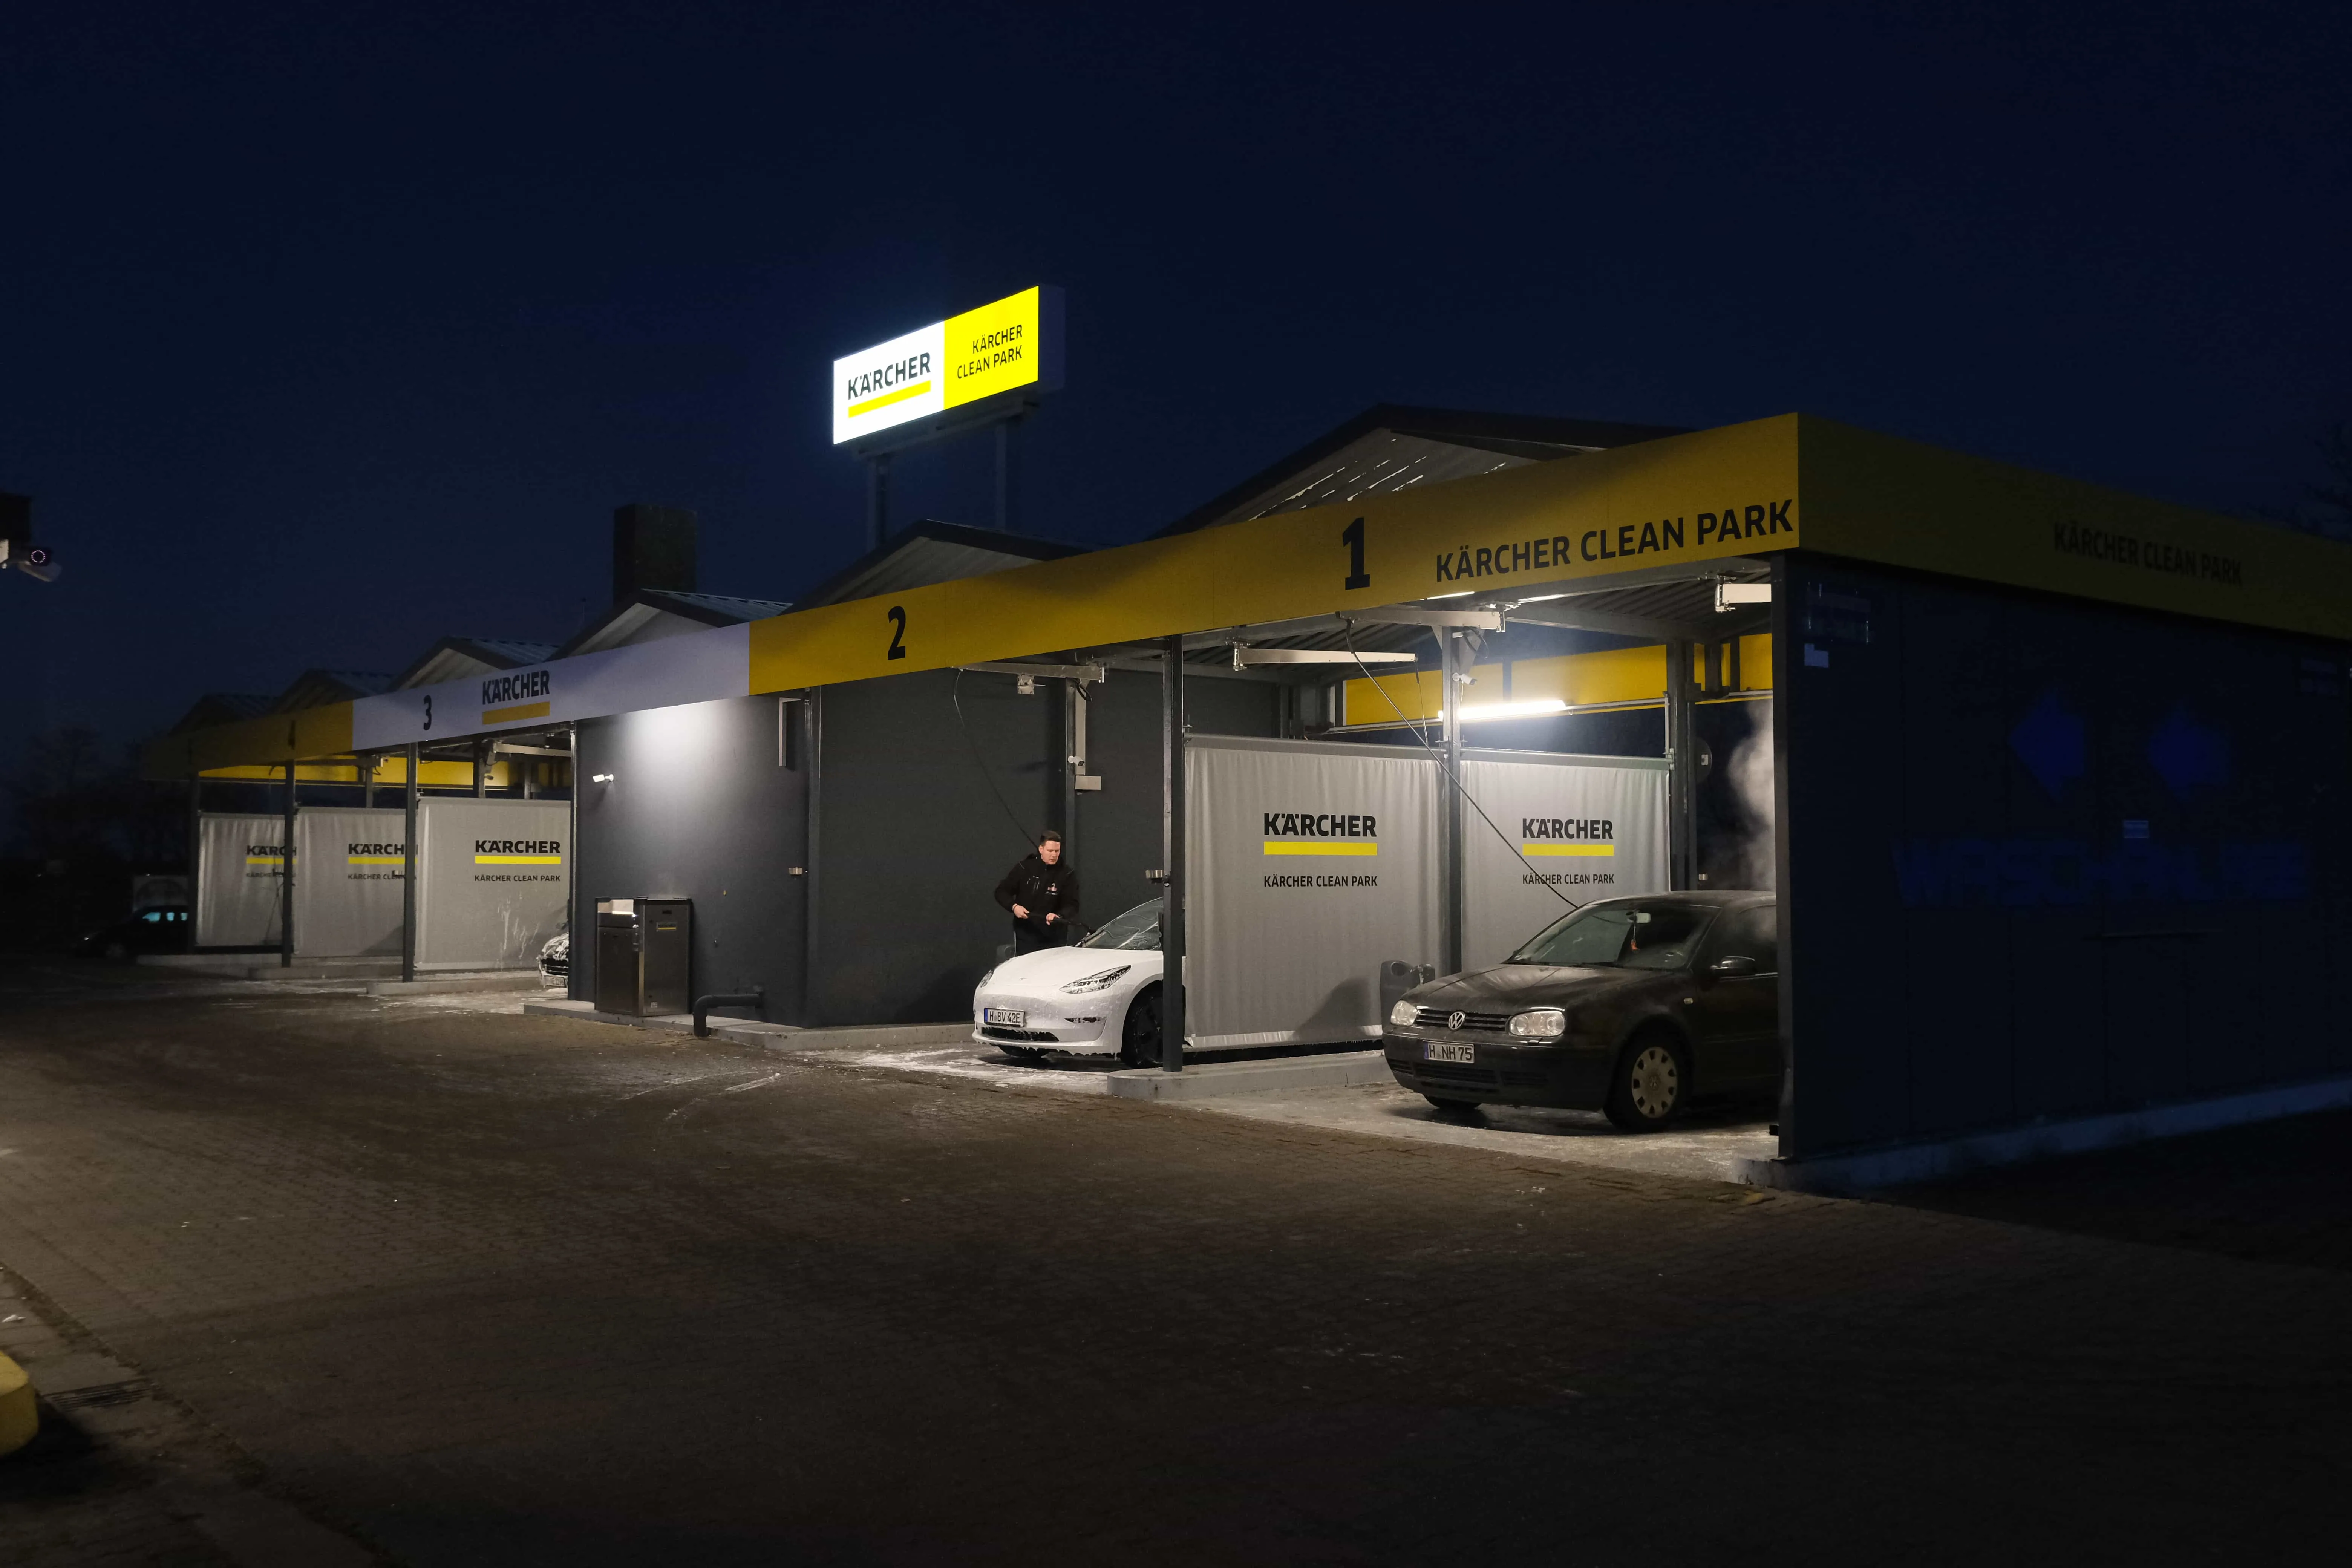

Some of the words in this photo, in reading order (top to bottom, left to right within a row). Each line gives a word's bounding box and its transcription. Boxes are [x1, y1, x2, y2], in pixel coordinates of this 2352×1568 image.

[972, 324, 1023, 354] KÄRCHER
[848, 352, 931, 400] KÄRCHER
[957, 355, 990, 379] CLEAN
[994, 345, 1023, 368] PARK
[1343, 517, 1370, 590] 1
[1437, 536, 1571, 582] KÄRCHER
[1581, 517, 1684, 562] CLEAN
[1698, 499, 1793, 545] PARK
[2054, 520, 2139, 565] KÄRCHER
[2144, 540, 2196, 576] CLEAN
[2202, 553, 2242, 587] PARK
[888, 606, 906, 660] 2
[482, 670, 550, 705] KÄRCHER
[424, 695, 432, 730] 3
[1264, 813, 1377, 837] KÄRCHER
[1522, 818, 1614, 839] KÄRCHER
[348, 843, 418, 855] KÄRCH
[475, 840, 561, 853] KÄRCHER
[1264, 874, 1313, 887] KÄRCHER
[1316, 876, 1348, 887] CLEAN
[1351, 875, 1378, 887] PARK
[1523, 872, 1562, 884] KÄRCHER
[1564, 874, 1590, 884] CLEAN
[1593, 874, 1614, 884] PARK
[989, 1011, 994, 1021] H
[997, 1011, 1006, 1023] BV
[1008, 1012, 1021, 1023] 42E
[1429, 1044, 1435, 1057] H
[1442, 1046, 1456, 1060] NH
[1458, 1047, 1472, 1061] 75
